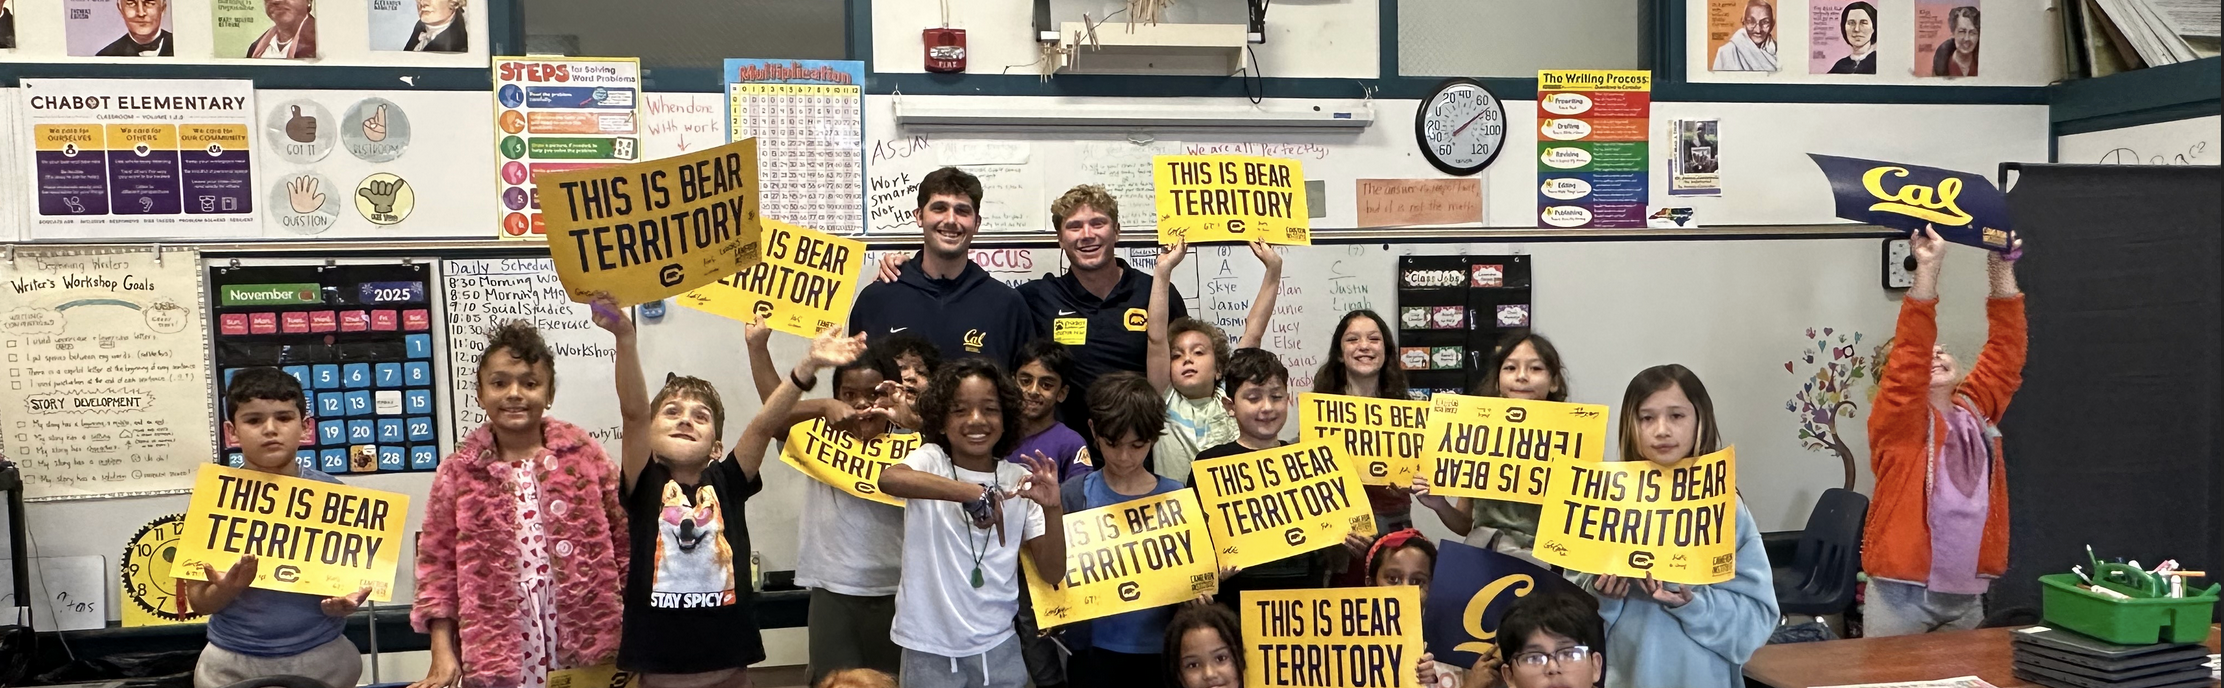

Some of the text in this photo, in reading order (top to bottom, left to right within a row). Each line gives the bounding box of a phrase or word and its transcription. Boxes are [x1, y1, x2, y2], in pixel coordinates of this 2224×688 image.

[499, 61, 570, 83] STEPS
[585, 66, 616, 75] Solving
[738, 61, 852, 84] Multiplication
[938, 60, 957, 68] FIRE
[596, 75, 636, 83] Problems
[1543, 72, 1649, 86] The Writing Process:
[30, 96, 246, 110] CHABOT ELEMENTARY
[1476, 94, 1489, 106] 60
[1484, 110, 1498, 121] 80
[684, 118, 719, 133] work
[1484, 124, 1501, 136] 100
[286, 144, 316, 155] GOT IT
[1187, 143, 1205, 156] We
[1210, 144, 1229, 155] are
[1438, 144, 1453, 156] 60
[1471, 143, 1489, 155] 120
[870, 172, 910, 192] Work
[1167, 161, 1292, 188] THIS IS BEAR
[559, 152, 744, 222] THIS IS BEAR
[1363, 182, 1382, 195] The
[1384, 185, 1416, 195] answer
[1169, 188, 1293, 219] TERRITORY
[1862, 166, 1974, 227] Cal
[870, 204, 895, 221] Not
[1364, 199, 1442, 213] but it not the
[282, 215, 328, 227] QUESTION
[568, 195, 744, 273] TERRITORY
[766, 227, 850, 276] IS BEAR
[1217, 243, 1365, 257] (8) (7)
[38, 257, 129, 274] Beginning Writers
[450, 259, 554, 275] Daily Schedul
[1219, 258, 1342, 276] A C
[10, 273, 155, 294] Writer's Workshop Goals
[449, 275, 533, 292] 8:30 Morning
[717, 262, 842, 311] ERRITORY
[1410, 272, 1460, 284] Class Jobs
[230, 288, 411, 301] November 2025
[1207, 280, 1238, 296] Skye
[449, 289, 480, 301] 8:50
[485, 288, 540, 306] Morning
[449, 301, 574, 316] 9:10 Social Studies
[449, 313, 591, 331] 10:05 Exercise
[451, 325, 483, 335] 10:30
[1272, 319, 1300, 334] Lucy
[415, 340, 422, 352] 1
[453, 337, 484, 352] 11:00
[963, 328, 987, 347] Cal
[1274, 335, 1302, 350] Elsie
[556, 342, 616, 364] Workshop
[321, 368, 422, 381] 5 6 7 8
[30, 396, 142, 409] STORY DEVELOPMENT
[323, 395, 425, 411] 12 13 15
[1313, 399, 1429, 430] THIS IS BEA
[324, 423, 429, 439] 19 20 21 22
[861, 438, 918, 460] IS BE
[1314, 426, 1424, 459] TRRITOR
[230, 451, 432, 468] 23 26 28 29
[806, 431, 893, 481] TERRIT
[1206, 445, 1340, 498] THIS IS BEAR
[1433, 457, 1521, 493] IS BEAR
[1571, 459, 1727, 503] THIS IS BEAR
[216, 474, 389, 532] THIS IS BEAR
[1216, 476, 1351, 538] TERRITORY
[1095, 498, 1188, 542] IS BEAR
[1563, 499, 1727, 547] TERRITORY
[154, 527, 164, 541] 11
[206, 513, 384, 570] TERRITORY
[135, 543, 152, 557] 10
[1058, 529, 1196, 591] ERRITORY
[129, 563, 140, 577] 9
[137, 583, 147, 597] 8
[156, 596, 168, 611] 7
[650, 591, 724, 608] STAY SPICY
[1256, 597, 1403, 637] THIS IS BEAR
[1258, 643, 1403, 688] TERRITORY
